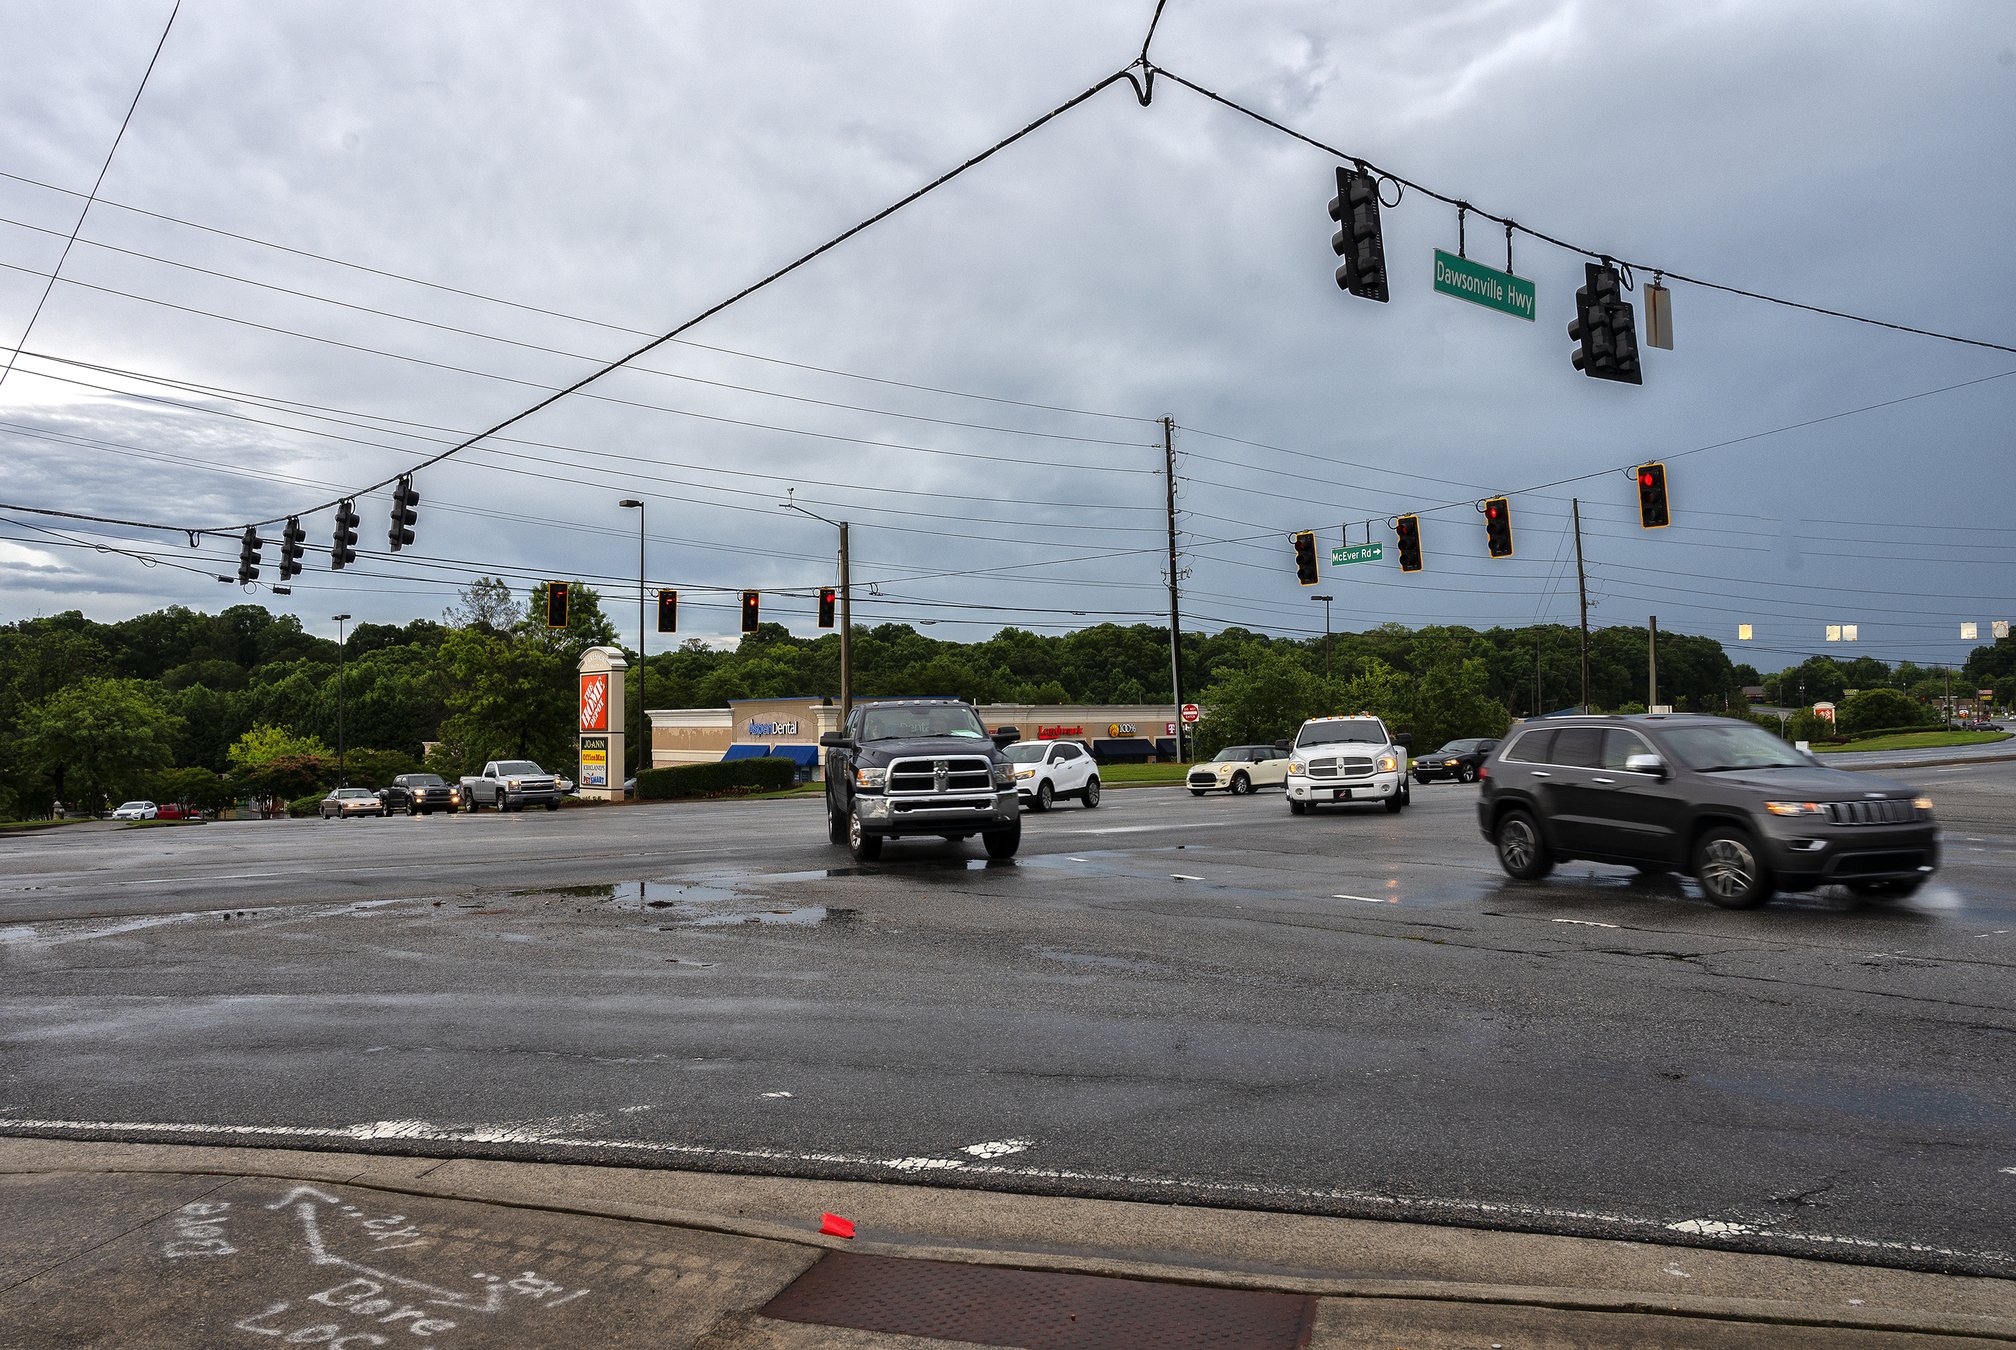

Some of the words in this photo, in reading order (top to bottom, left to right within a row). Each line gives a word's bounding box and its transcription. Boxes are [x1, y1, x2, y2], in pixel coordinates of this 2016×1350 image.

[1437, 260, 1503, 301] Dawsonville
[1508, 284, 1533, 315] Hwy
[1332, 551, 1360, 563] McEver
[1361, 548, 1372, 559] Rd
[581, 676, 605, 729] HOME
[589, 697, 604, 728] DEPOT
[1038, 724, 1083, 736] Lendmark
[1119, 722, 1136, 733] 100%
[582, 753, 605, 762] OfficeMax
